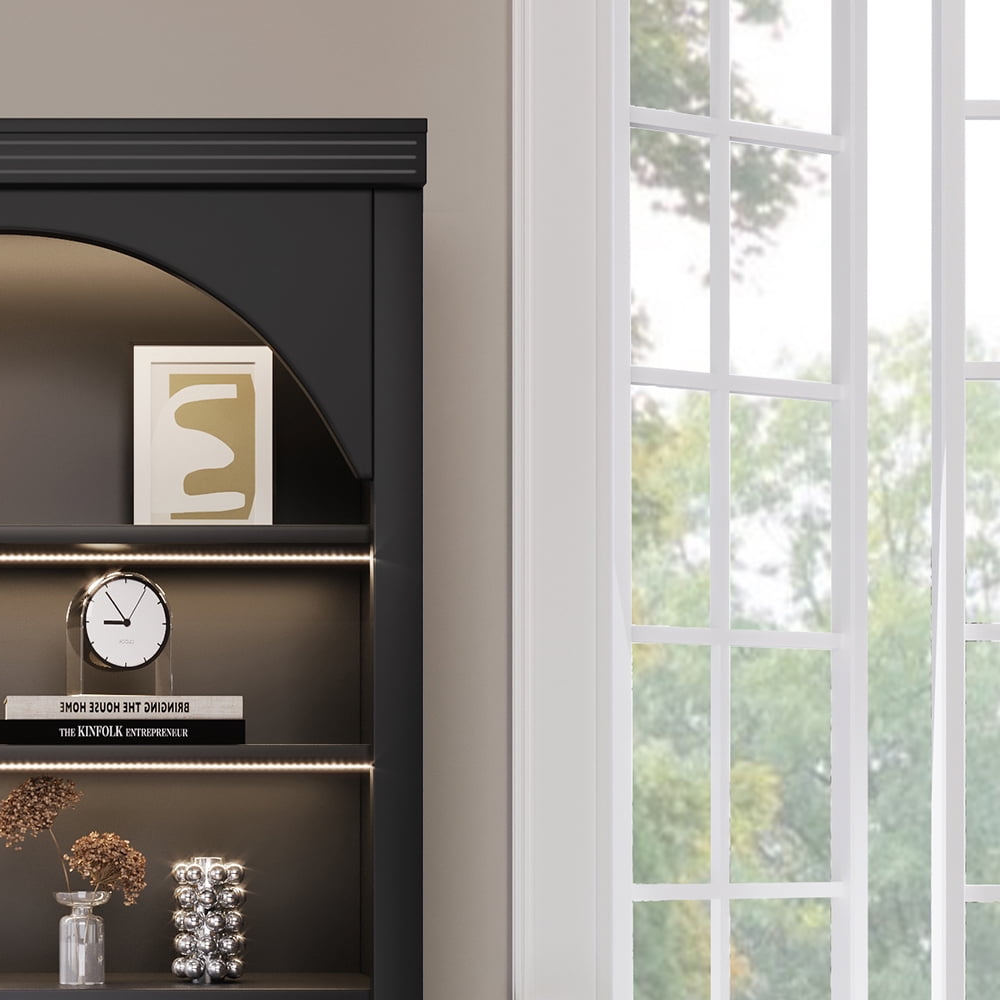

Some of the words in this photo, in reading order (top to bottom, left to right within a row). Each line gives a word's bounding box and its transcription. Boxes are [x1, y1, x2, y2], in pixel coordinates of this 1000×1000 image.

[59, 728, 76, 737] THE
[78, 725, 123, 737] KINFOLK
[126, 728, 188, 737] ENTREPRENEUR
